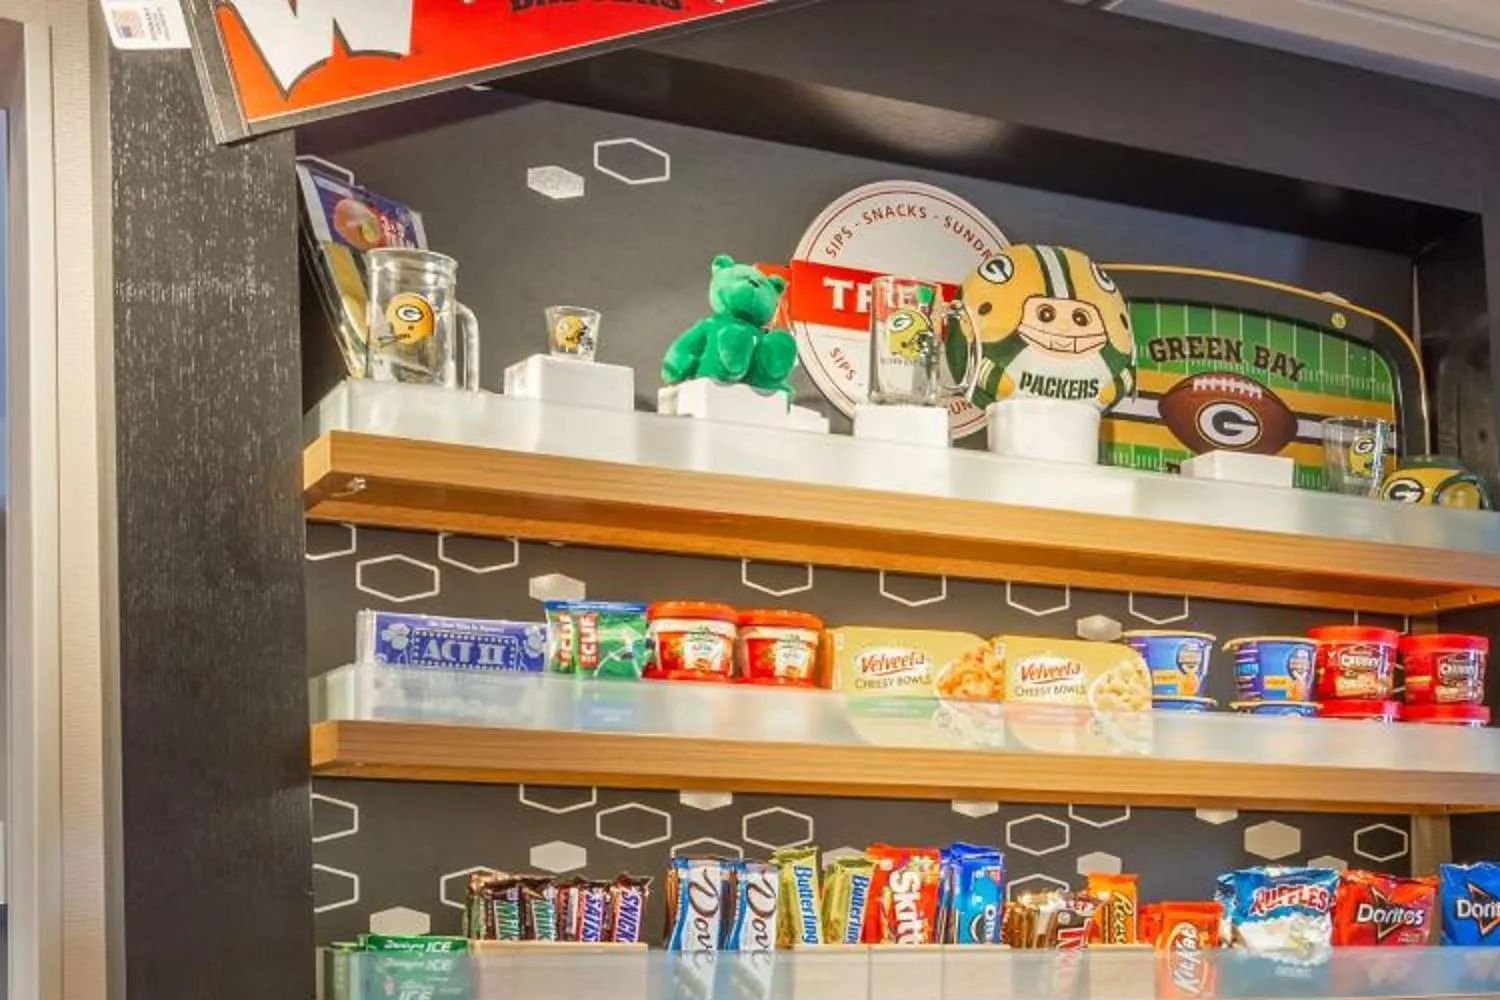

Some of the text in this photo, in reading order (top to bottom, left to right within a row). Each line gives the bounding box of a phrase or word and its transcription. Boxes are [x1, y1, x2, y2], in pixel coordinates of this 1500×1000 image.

[825, 228, 854, 258] SIPS
[862, 203, 927, 225] SNACKS
[1148, 336, 1306, 384] GREEN BAY
[1018, 371, 1099, 401] PACKERS
[423, 638, 473, 664] ACT
[860, 651, 926, 676] Velveeta
[1020, 659, 1081, 682] Velveeta
[1252, 886, 1329, 914] RUFFLES
[1356, 902, 1425, 926] Doritos
[426, 941, 453, 953] ICE
